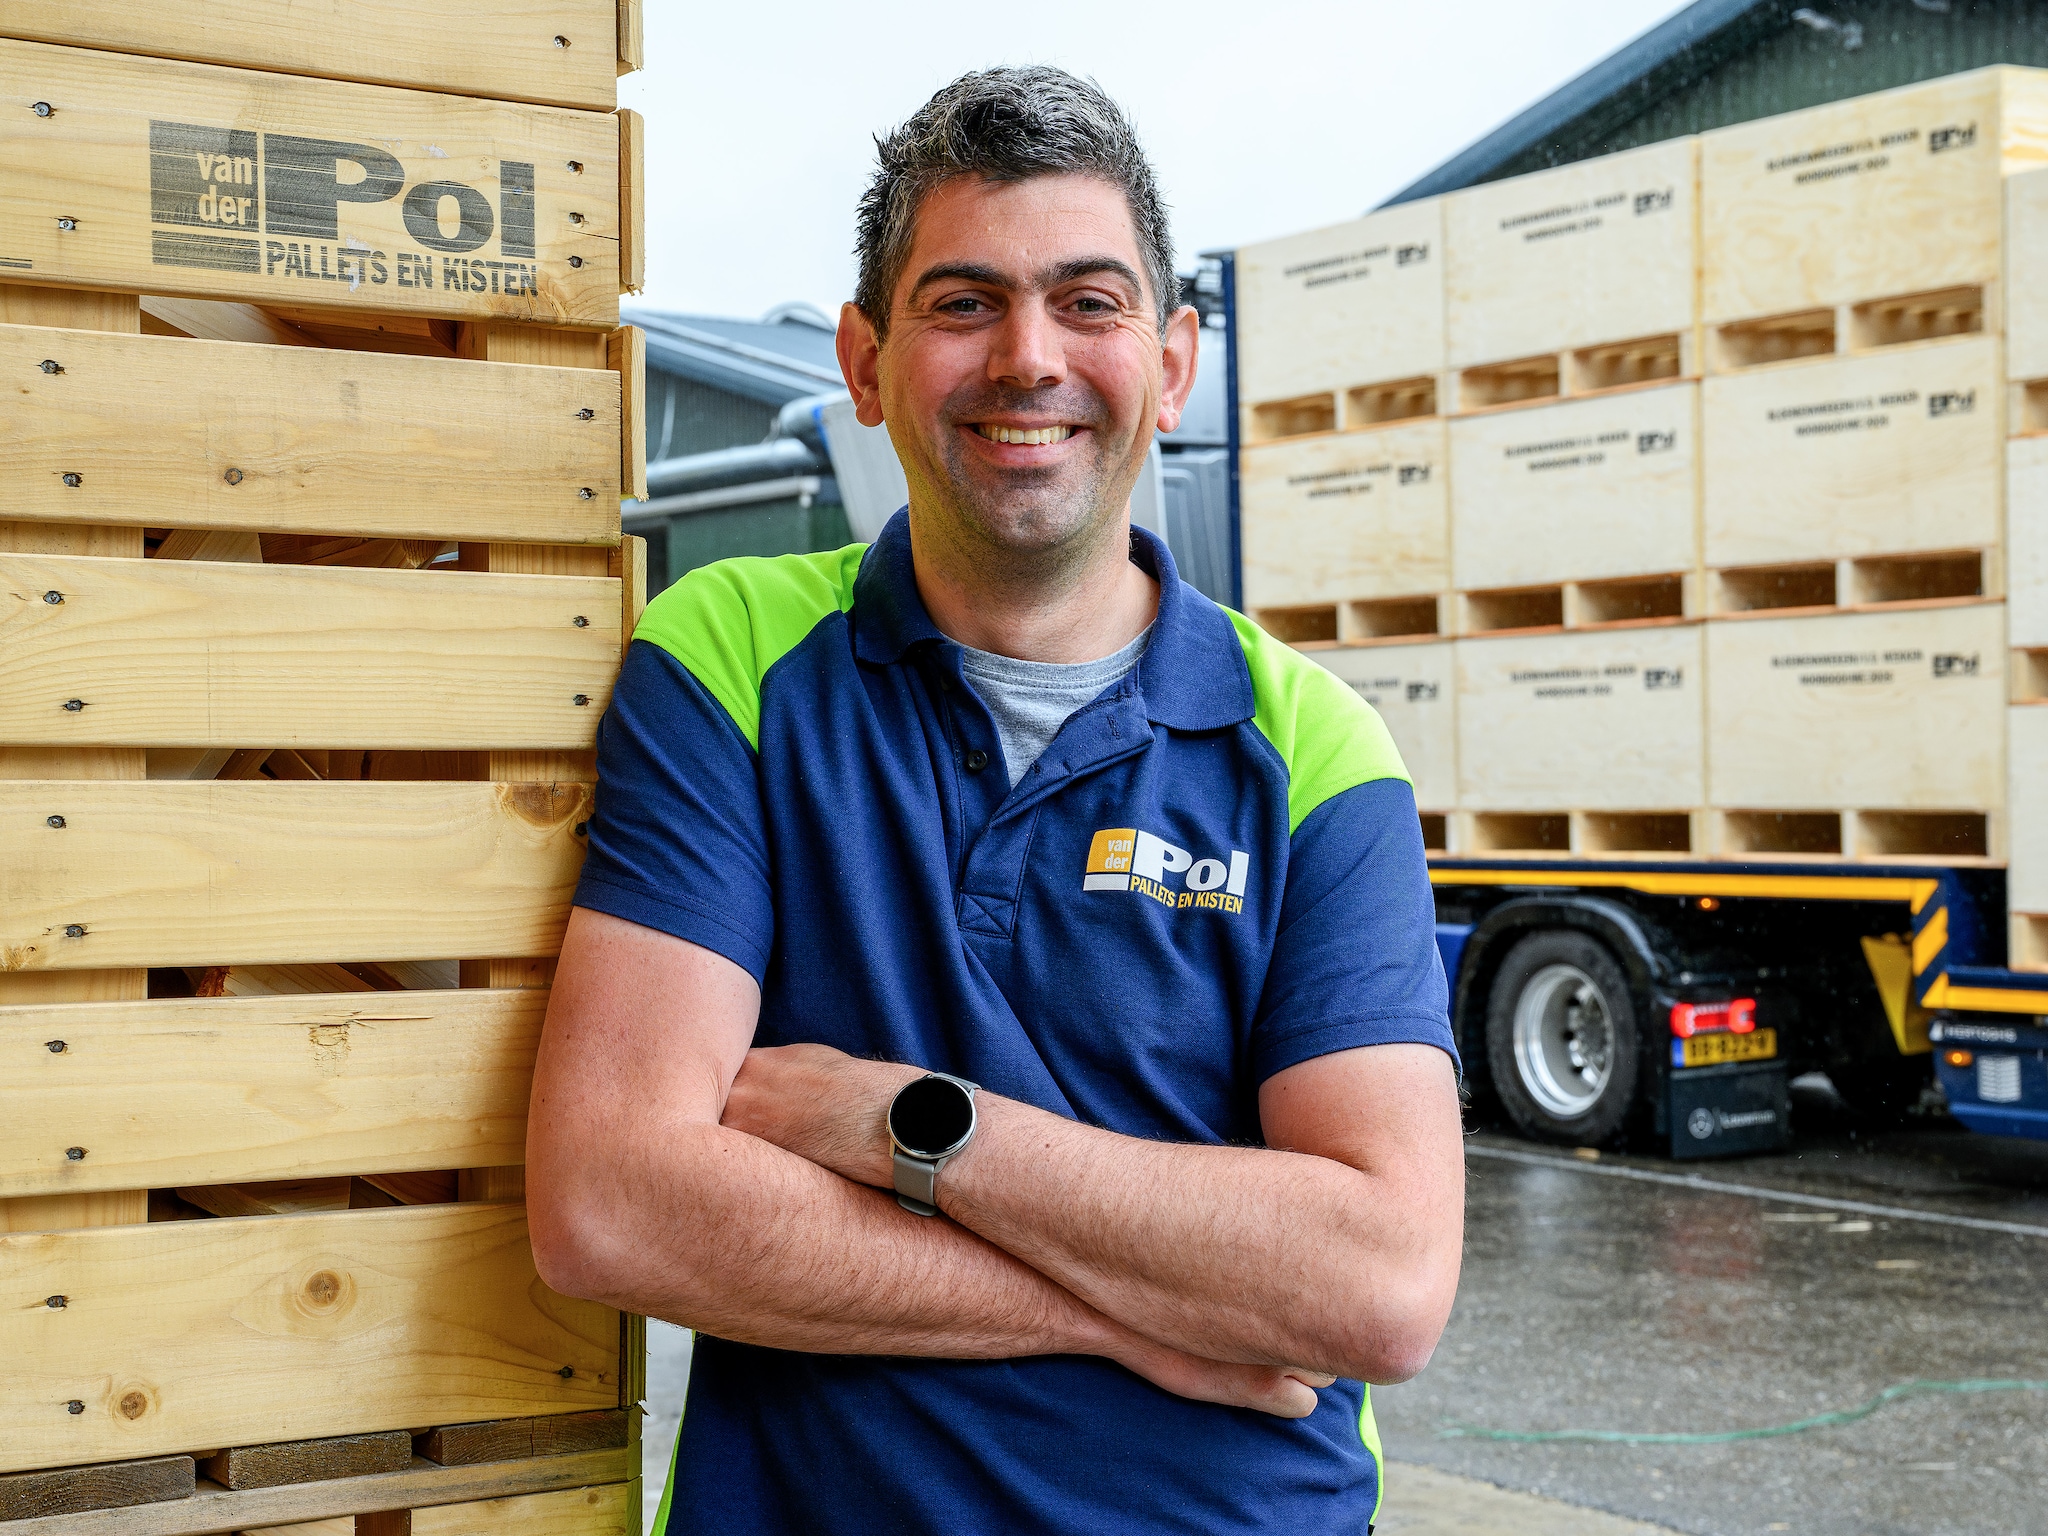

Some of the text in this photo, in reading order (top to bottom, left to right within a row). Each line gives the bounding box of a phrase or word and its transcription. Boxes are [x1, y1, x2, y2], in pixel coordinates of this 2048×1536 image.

[197, 151, 252, 186] van
[199, 185, 251, 226] der
[263, 133, 536, 259] Pol
[266, 240, 538, 297] PALLETS EN KISTEN
[1104, 853, 1129, 870] der
[1107, 839, 1132, 852] van
[1132, 829, 1250, 897] Pol
[1129, 875, 1244, 915] PALLETS EN KISTEN
